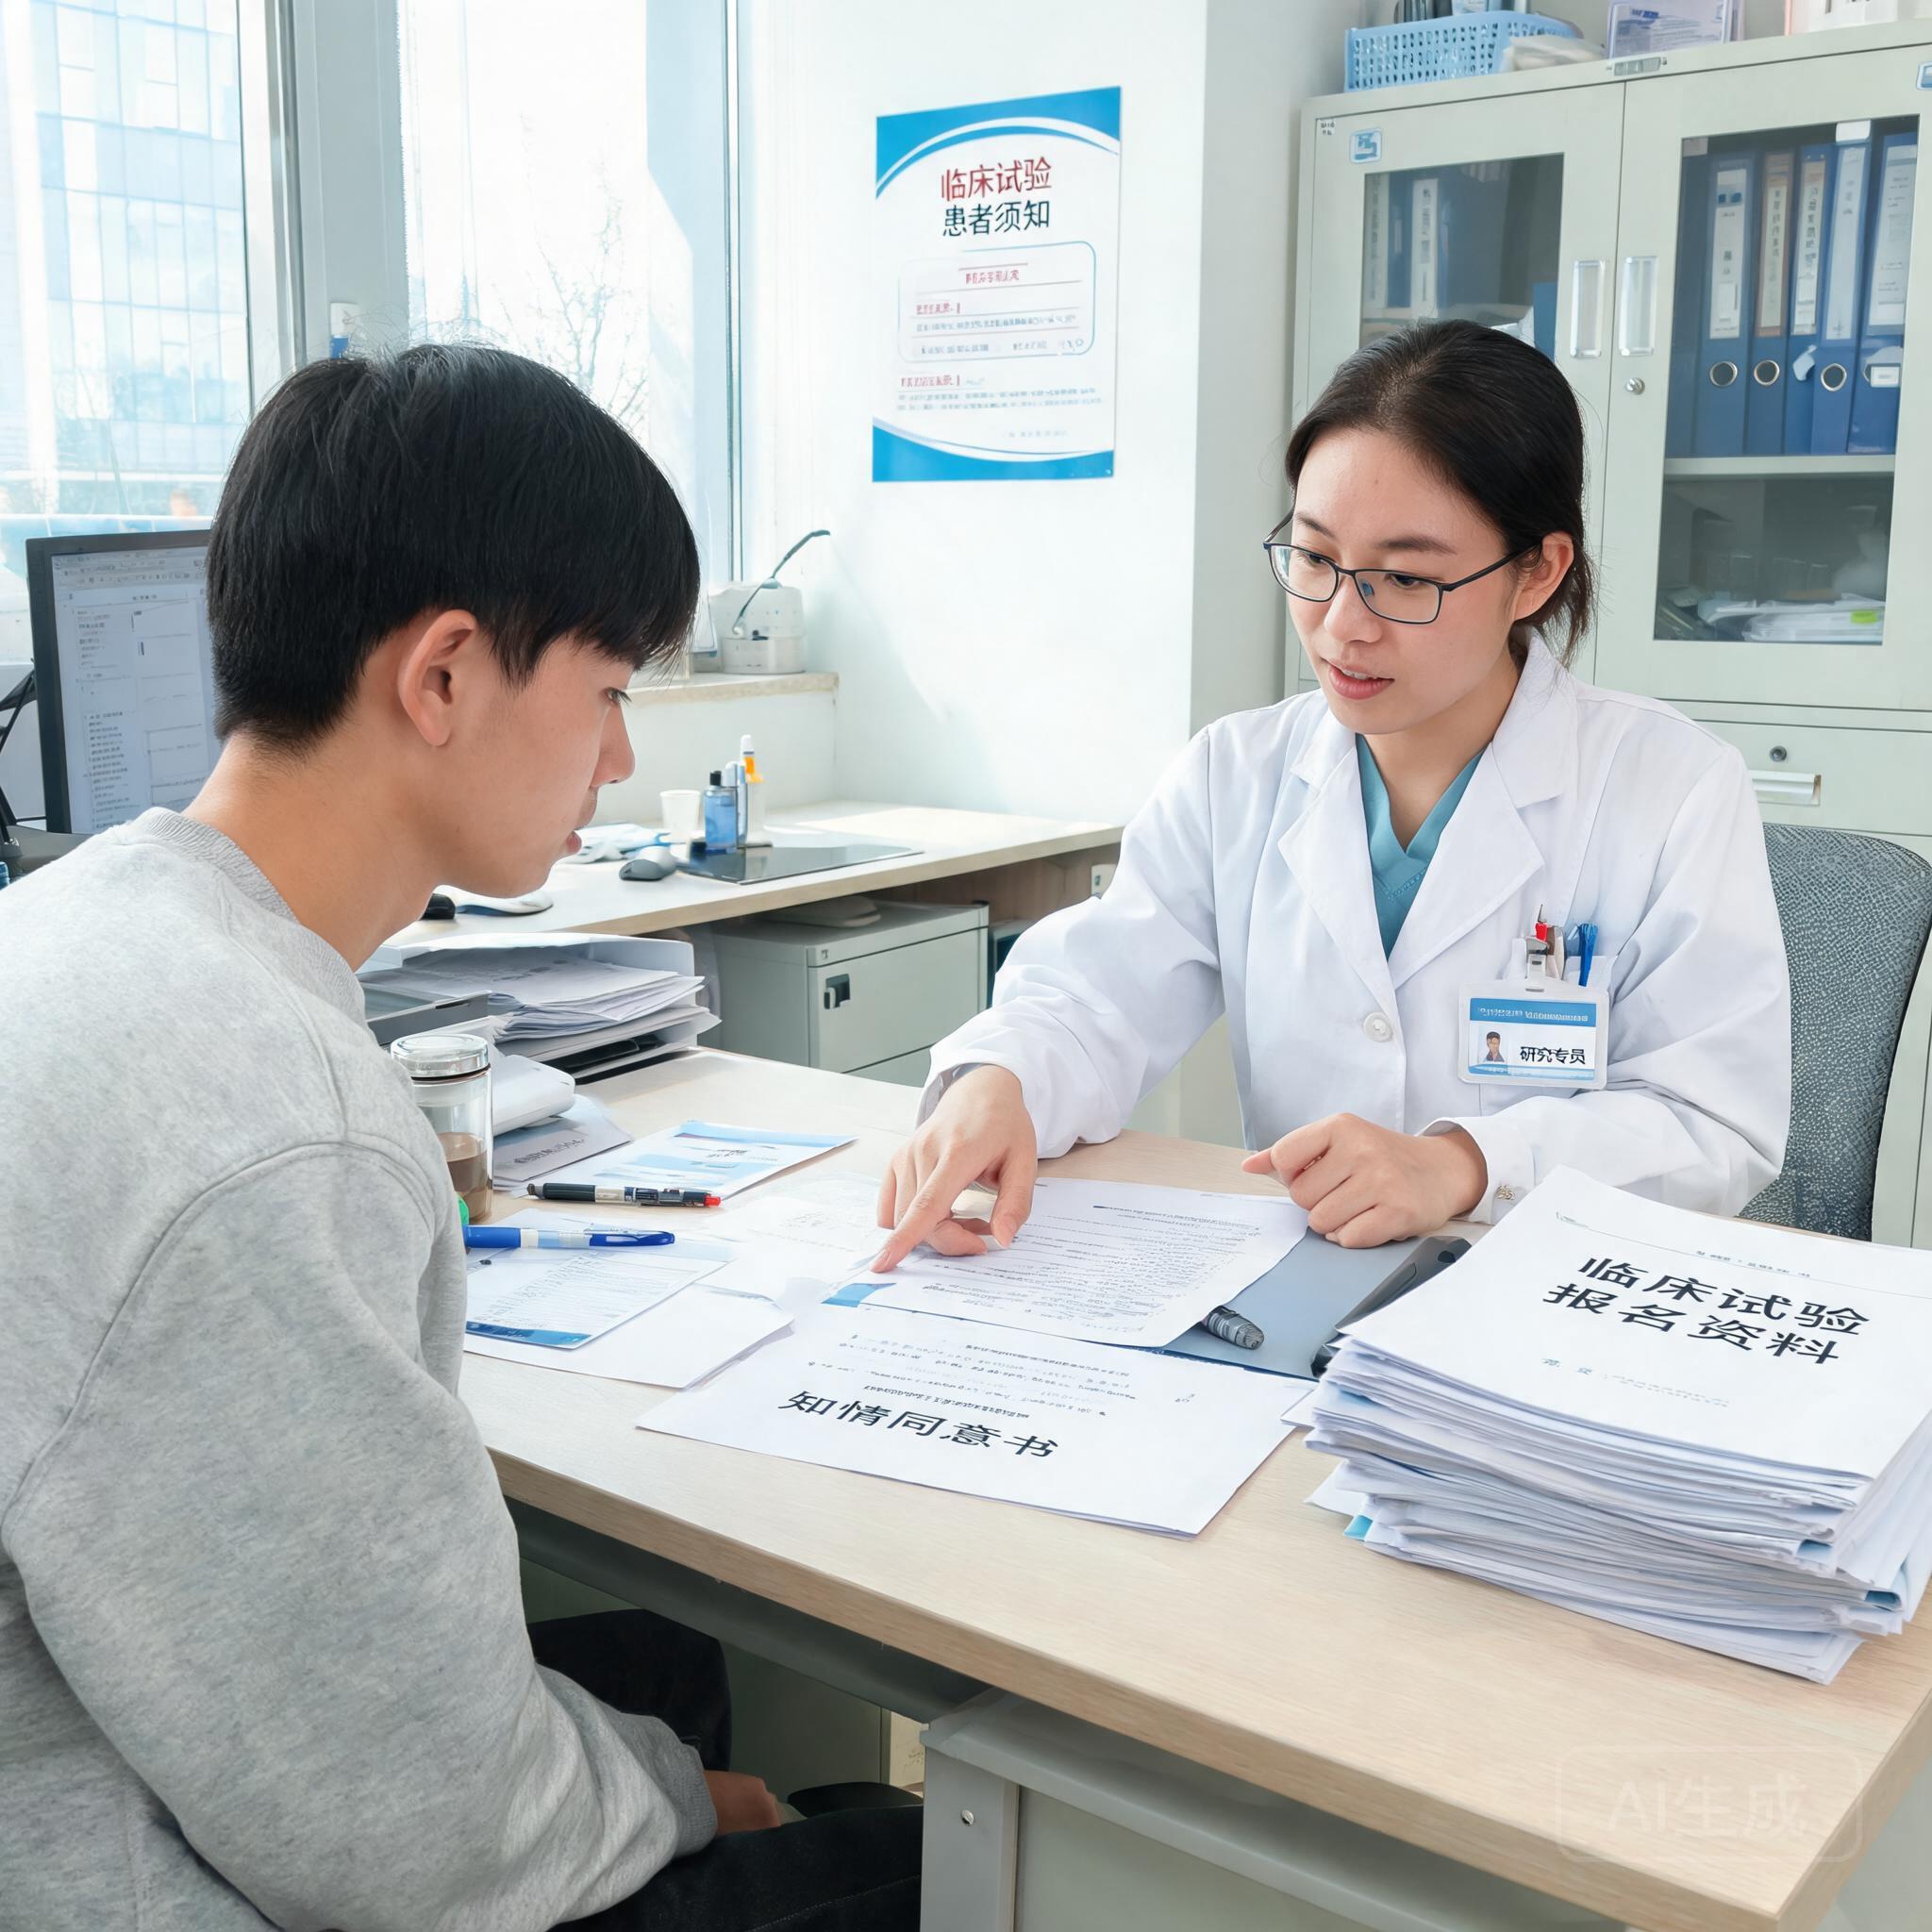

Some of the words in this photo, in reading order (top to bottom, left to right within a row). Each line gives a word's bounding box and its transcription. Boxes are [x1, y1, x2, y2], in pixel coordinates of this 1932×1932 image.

[941, 156, 1053, 202] 临床试验
[942, 199, 1051, 237] 患者须知
[1519, 1045, 1586, 1065] 研究专员
[1542, 1283, 1840, 1365] 报名资料
[1577, 1257, 1871, 1335] 临床试验
[778, 1390, 1059, 1457] 知情同意书
